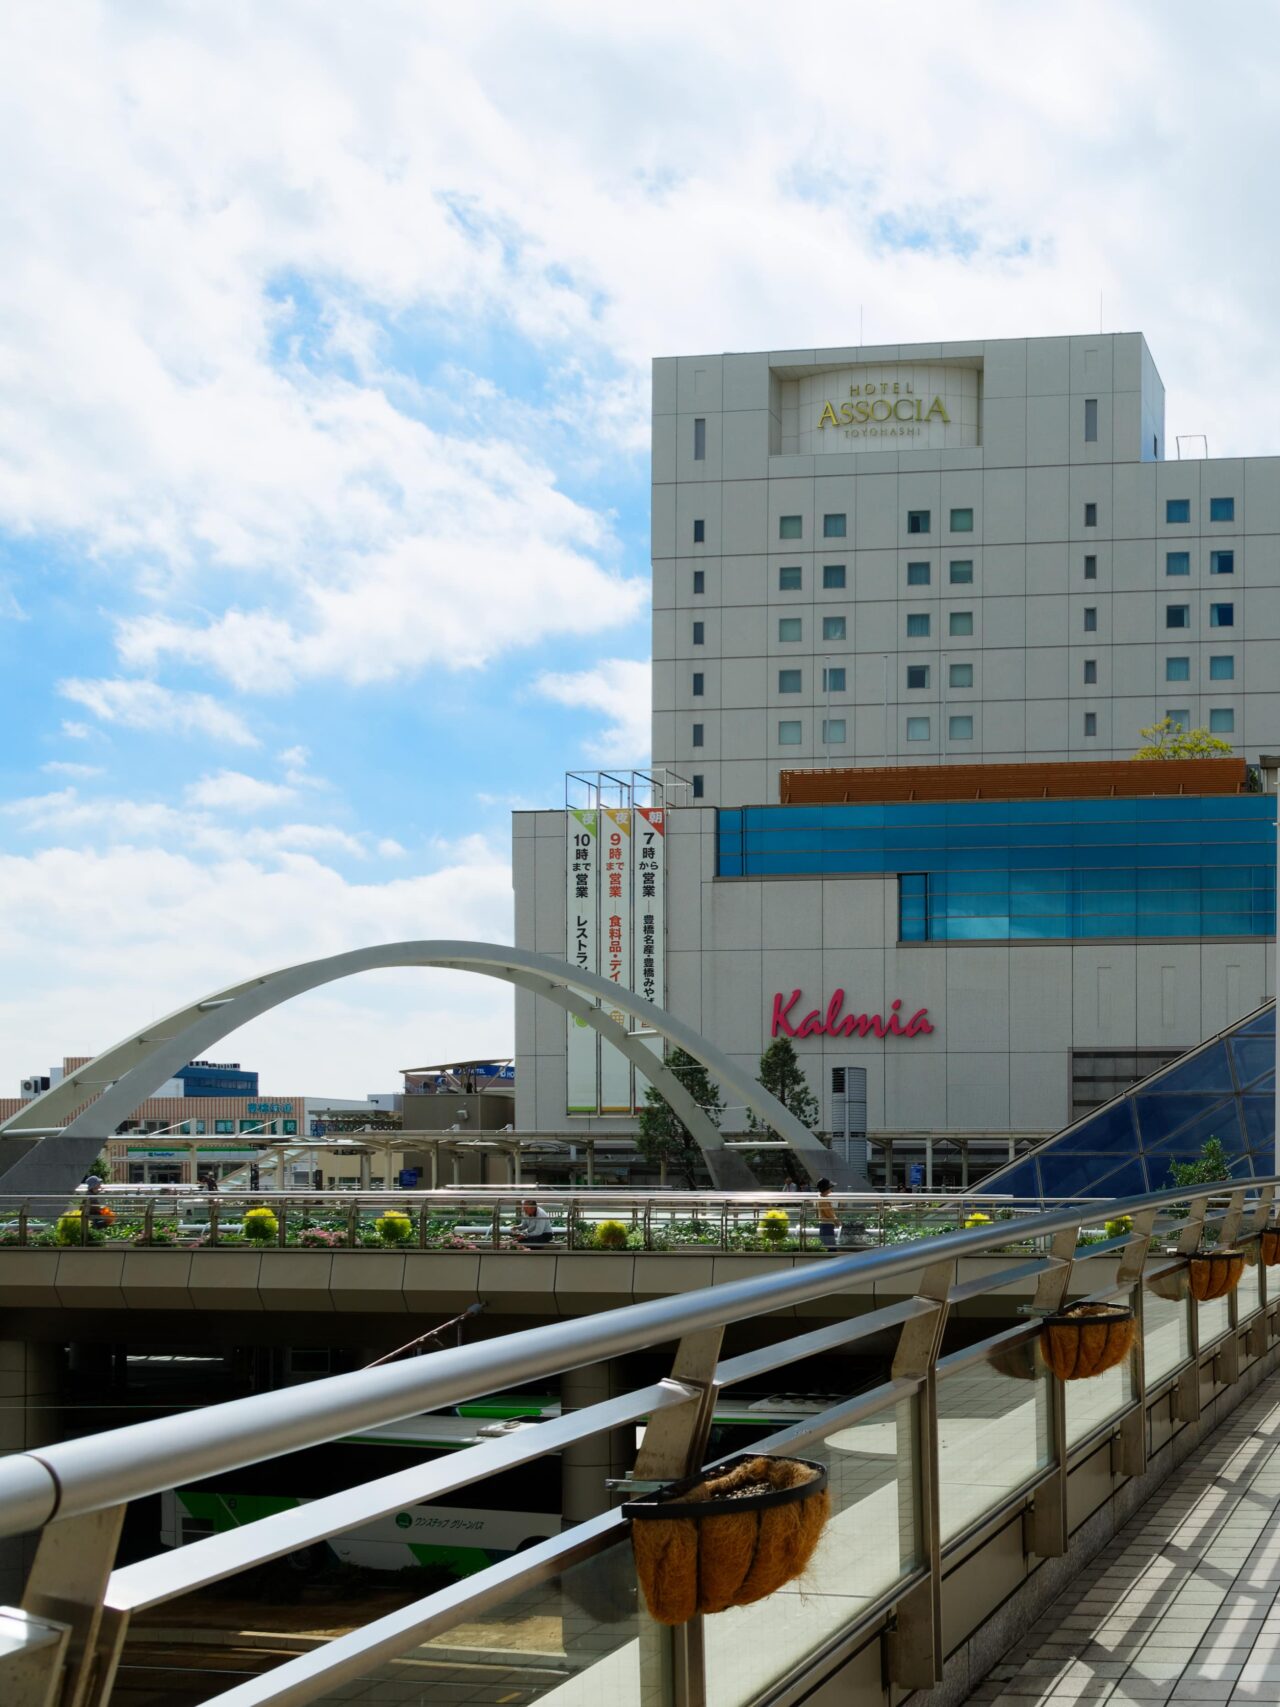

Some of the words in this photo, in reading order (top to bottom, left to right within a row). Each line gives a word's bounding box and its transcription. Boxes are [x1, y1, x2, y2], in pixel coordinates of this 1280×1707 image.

[817, 395, 951, 429] ASSOCIA
[850, 382, 913, 396] HOTEL
[843, 427, 921, 439] TOYOHASHI
[572, 833, 591, 898] 10時まで営業
[606, 833, 624, 898] 9時まで営業
[639, 832, 659, 897] 7時から営業
[576, 915, 588, 970] レストラ
[609, 914, 622, 985] 食料品・デイ
[771, 988, 935, 1039] Kalmia
